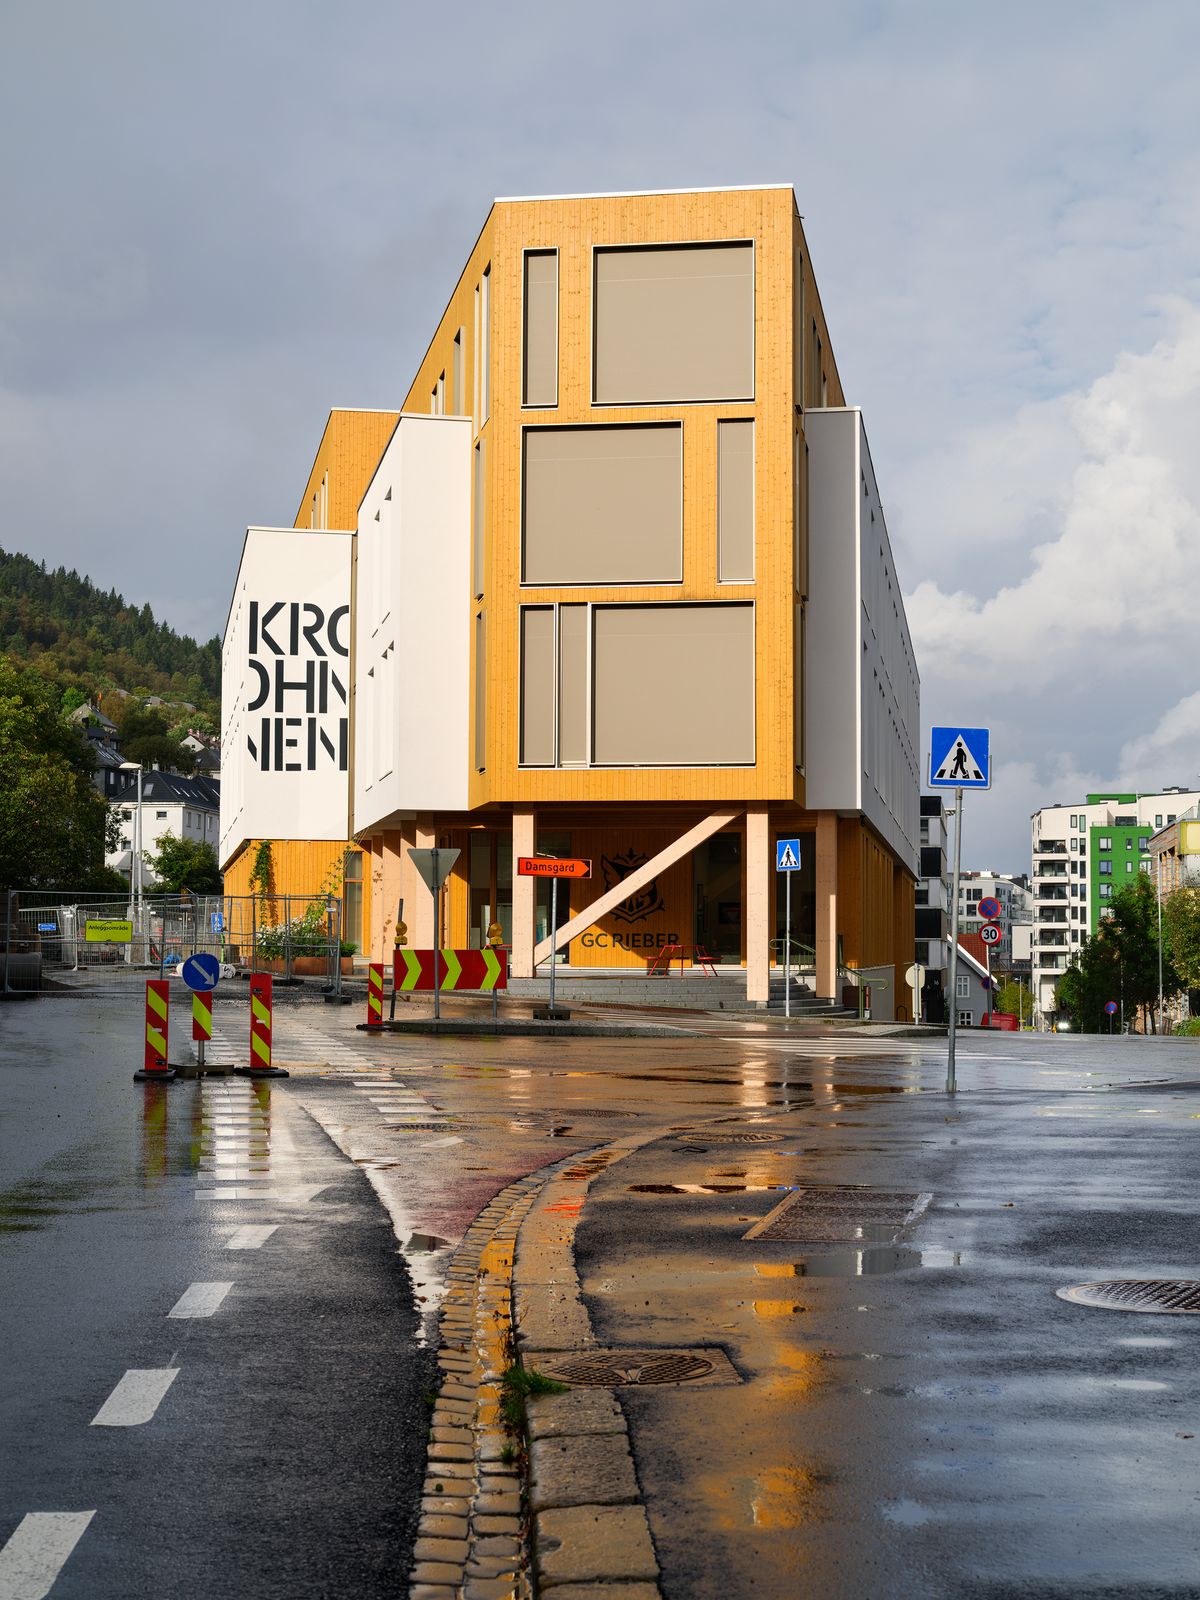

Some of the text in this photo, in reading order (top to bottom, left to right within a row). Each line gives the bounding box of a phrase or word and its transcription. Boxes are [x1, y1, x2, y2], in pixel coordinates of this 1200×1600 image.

[525, 861, 575, 874] Damsgård
[983, 929, 998, 940] 30
[581, 932, 680, 951] GC RIEBER
